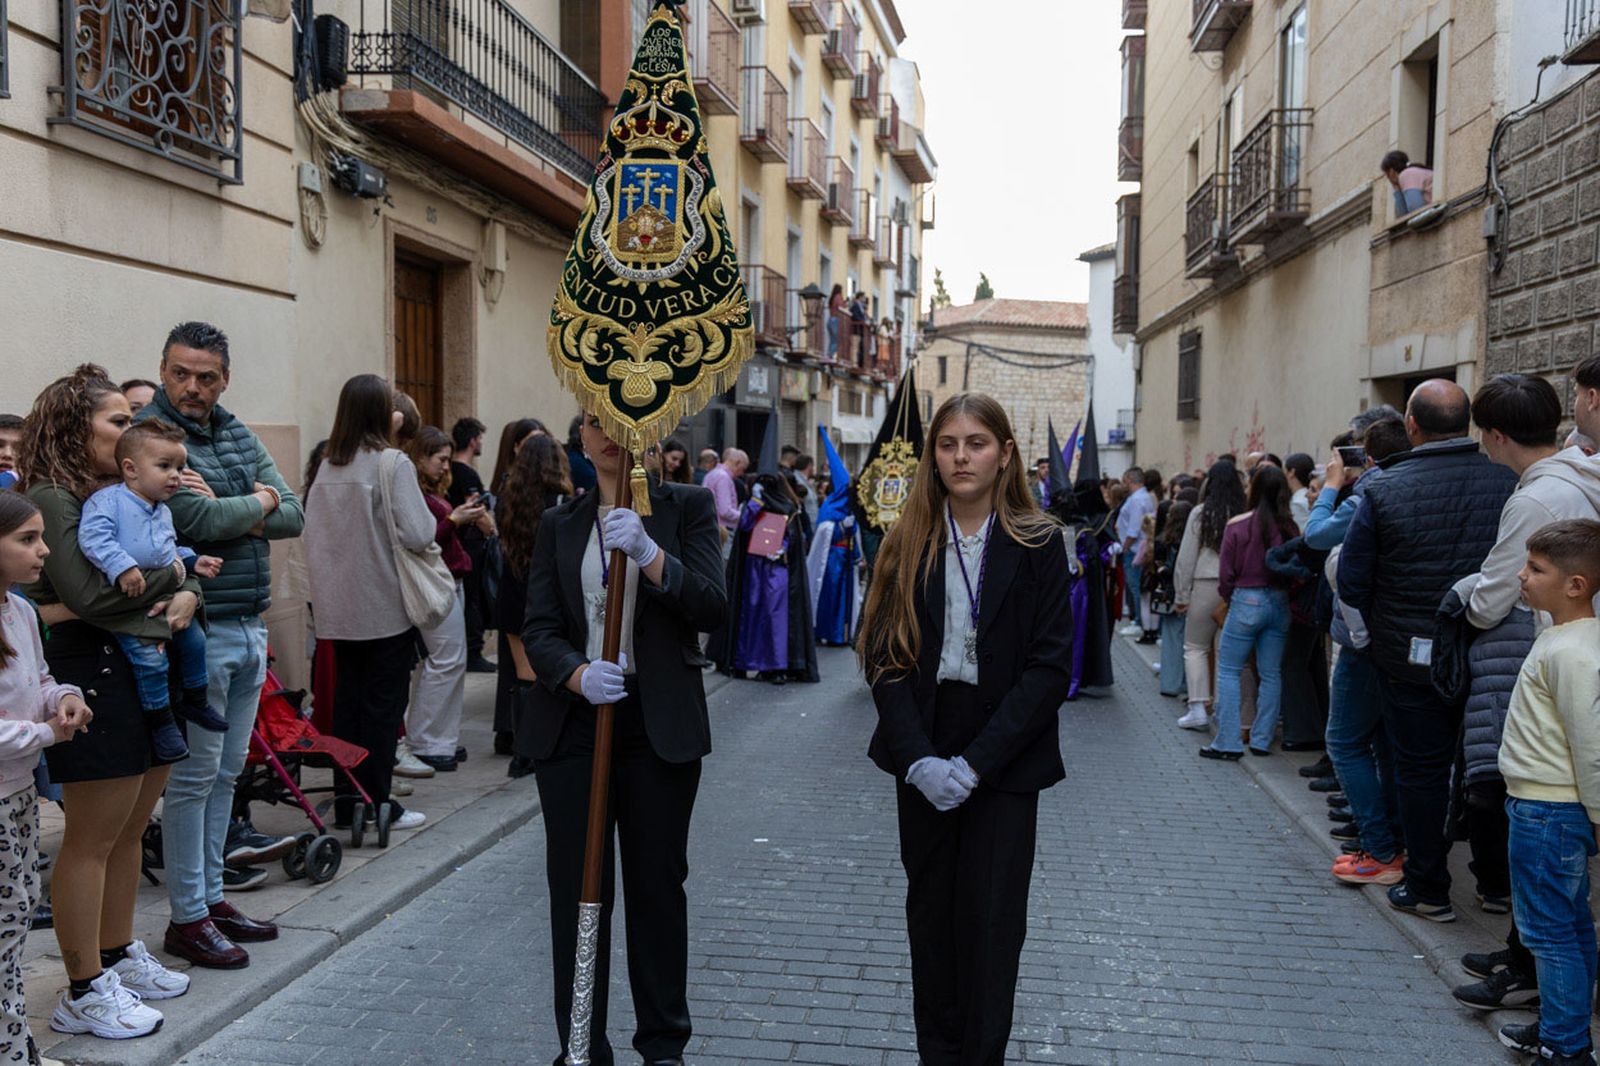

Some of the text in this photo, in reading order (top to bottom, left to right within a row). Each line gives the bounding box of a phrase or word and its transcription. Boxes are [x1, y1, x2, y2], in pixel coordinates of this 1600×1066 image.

[651, 28, 671, 37] LOS
[641, 37, 683, 48] OVENES
[638, 62, 677, 72] IGLESIA
[564, 242, 637, 319] VENTUD
[645, 284, 718, 320] VERA
